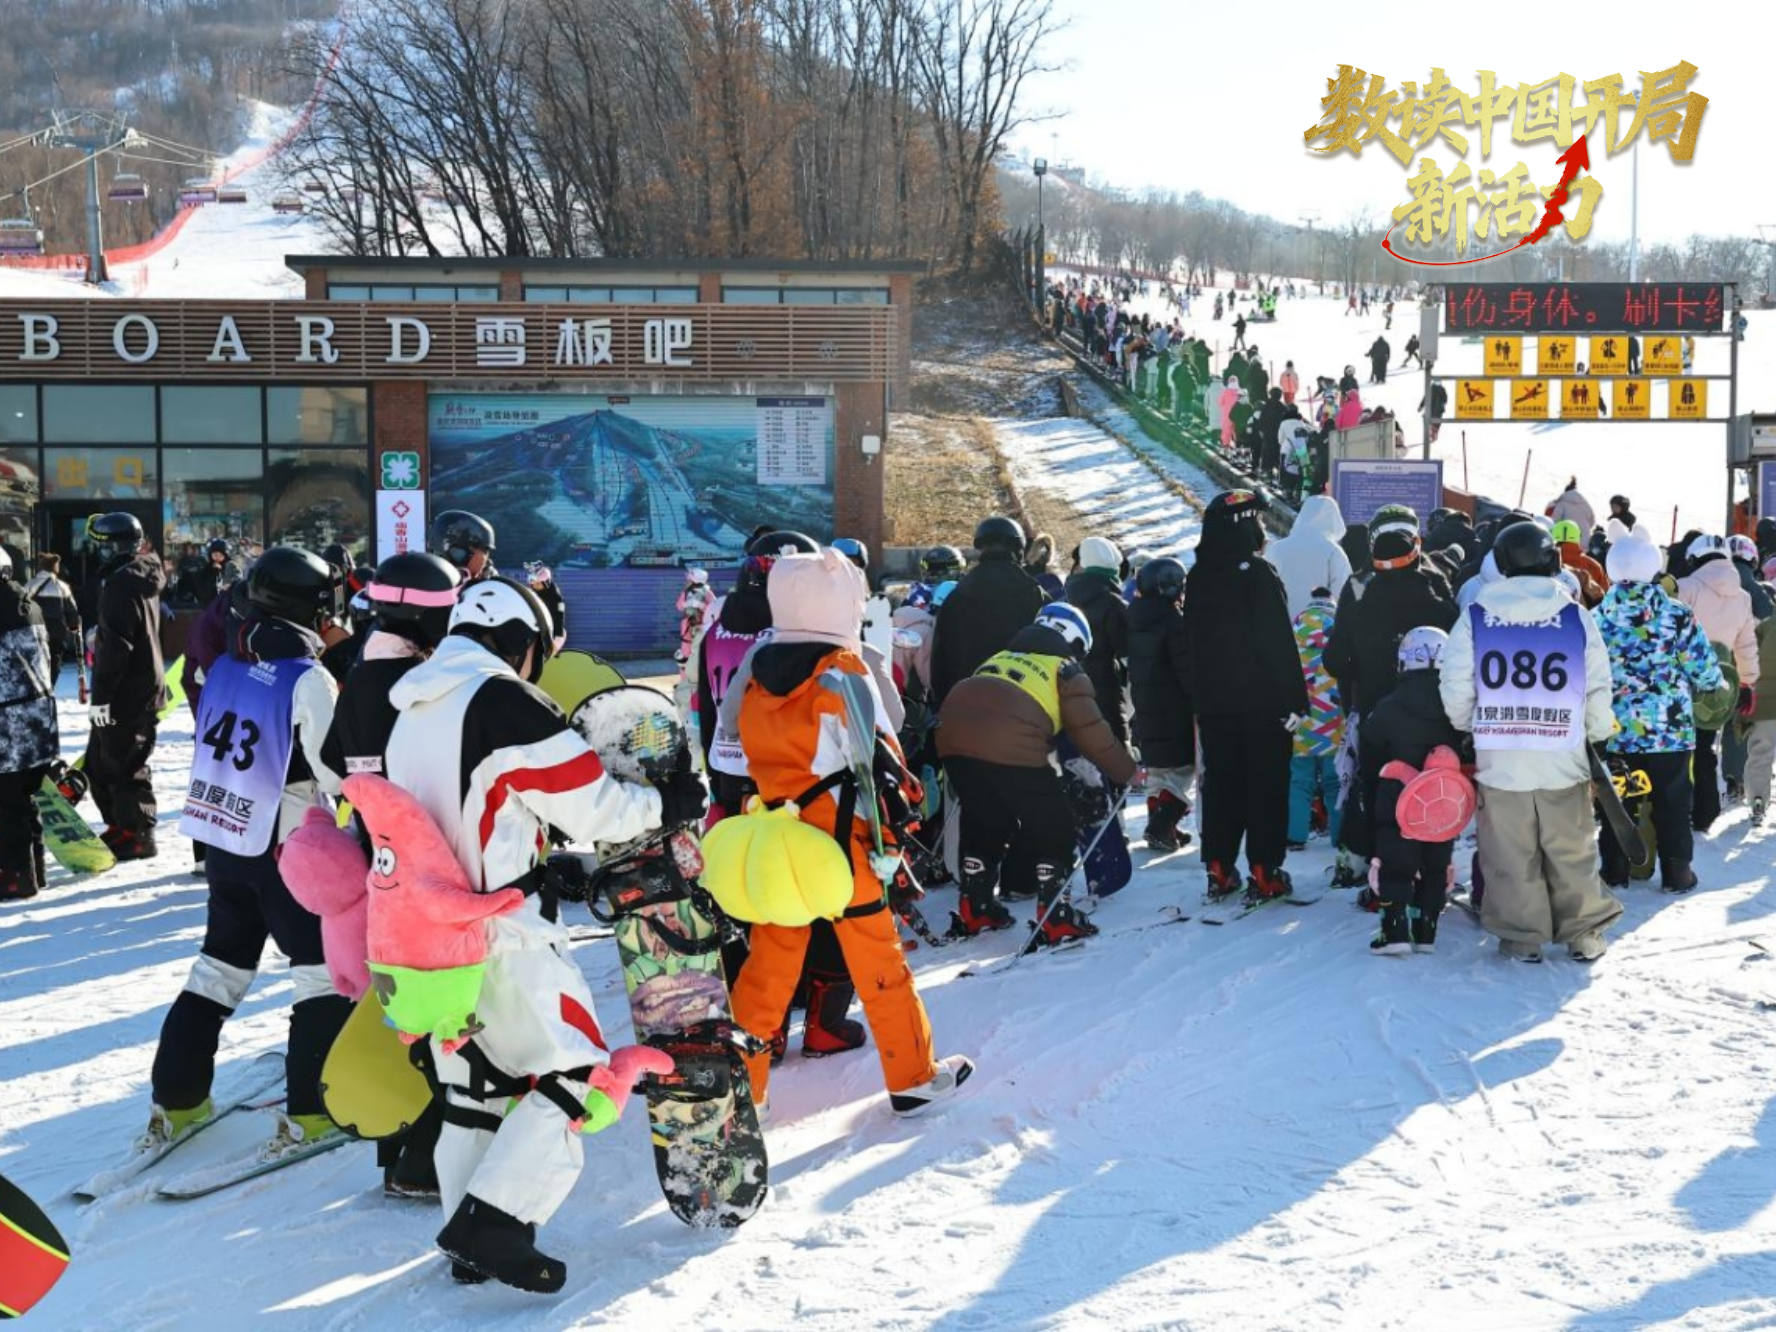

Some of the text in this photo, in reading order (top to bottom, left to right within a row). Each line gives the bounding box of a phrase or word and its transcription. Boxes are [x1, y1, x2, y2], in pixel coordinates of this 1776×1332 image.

[18, 313, 693, 367] BOARD 雪板吧
[57, 455, 144, 489] 出口
[1480, 650, 1569, 692] 086
